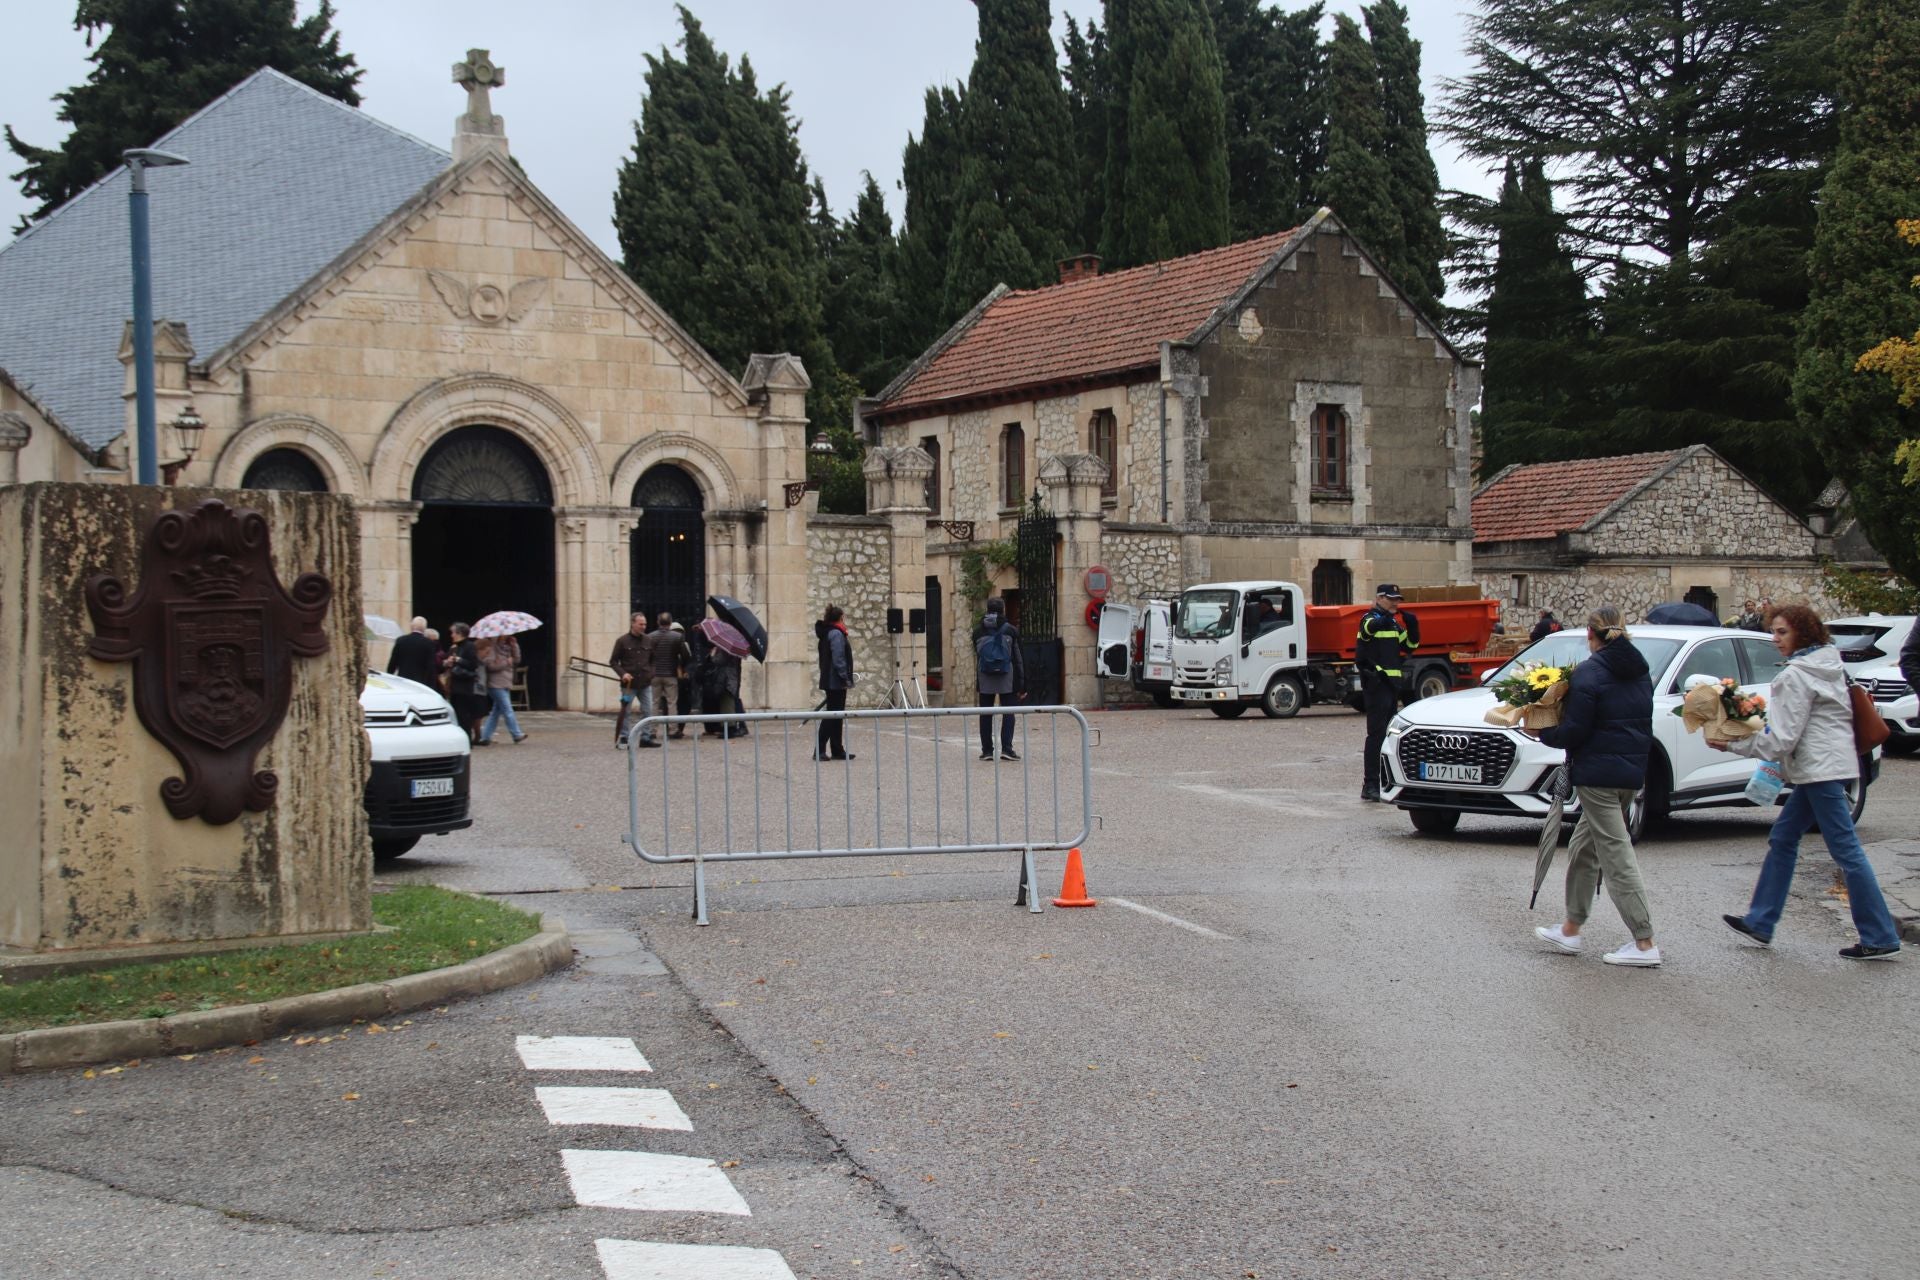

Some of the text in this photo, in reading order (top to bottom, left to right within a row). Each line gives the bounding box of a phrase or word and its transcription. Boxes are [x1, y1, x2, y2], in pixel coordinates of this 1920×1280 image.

[440, 332, 459, 347] DE
[465, 334, 493, 349] SAN
[1427, 765, 1479, 781] 0171 LNZ
